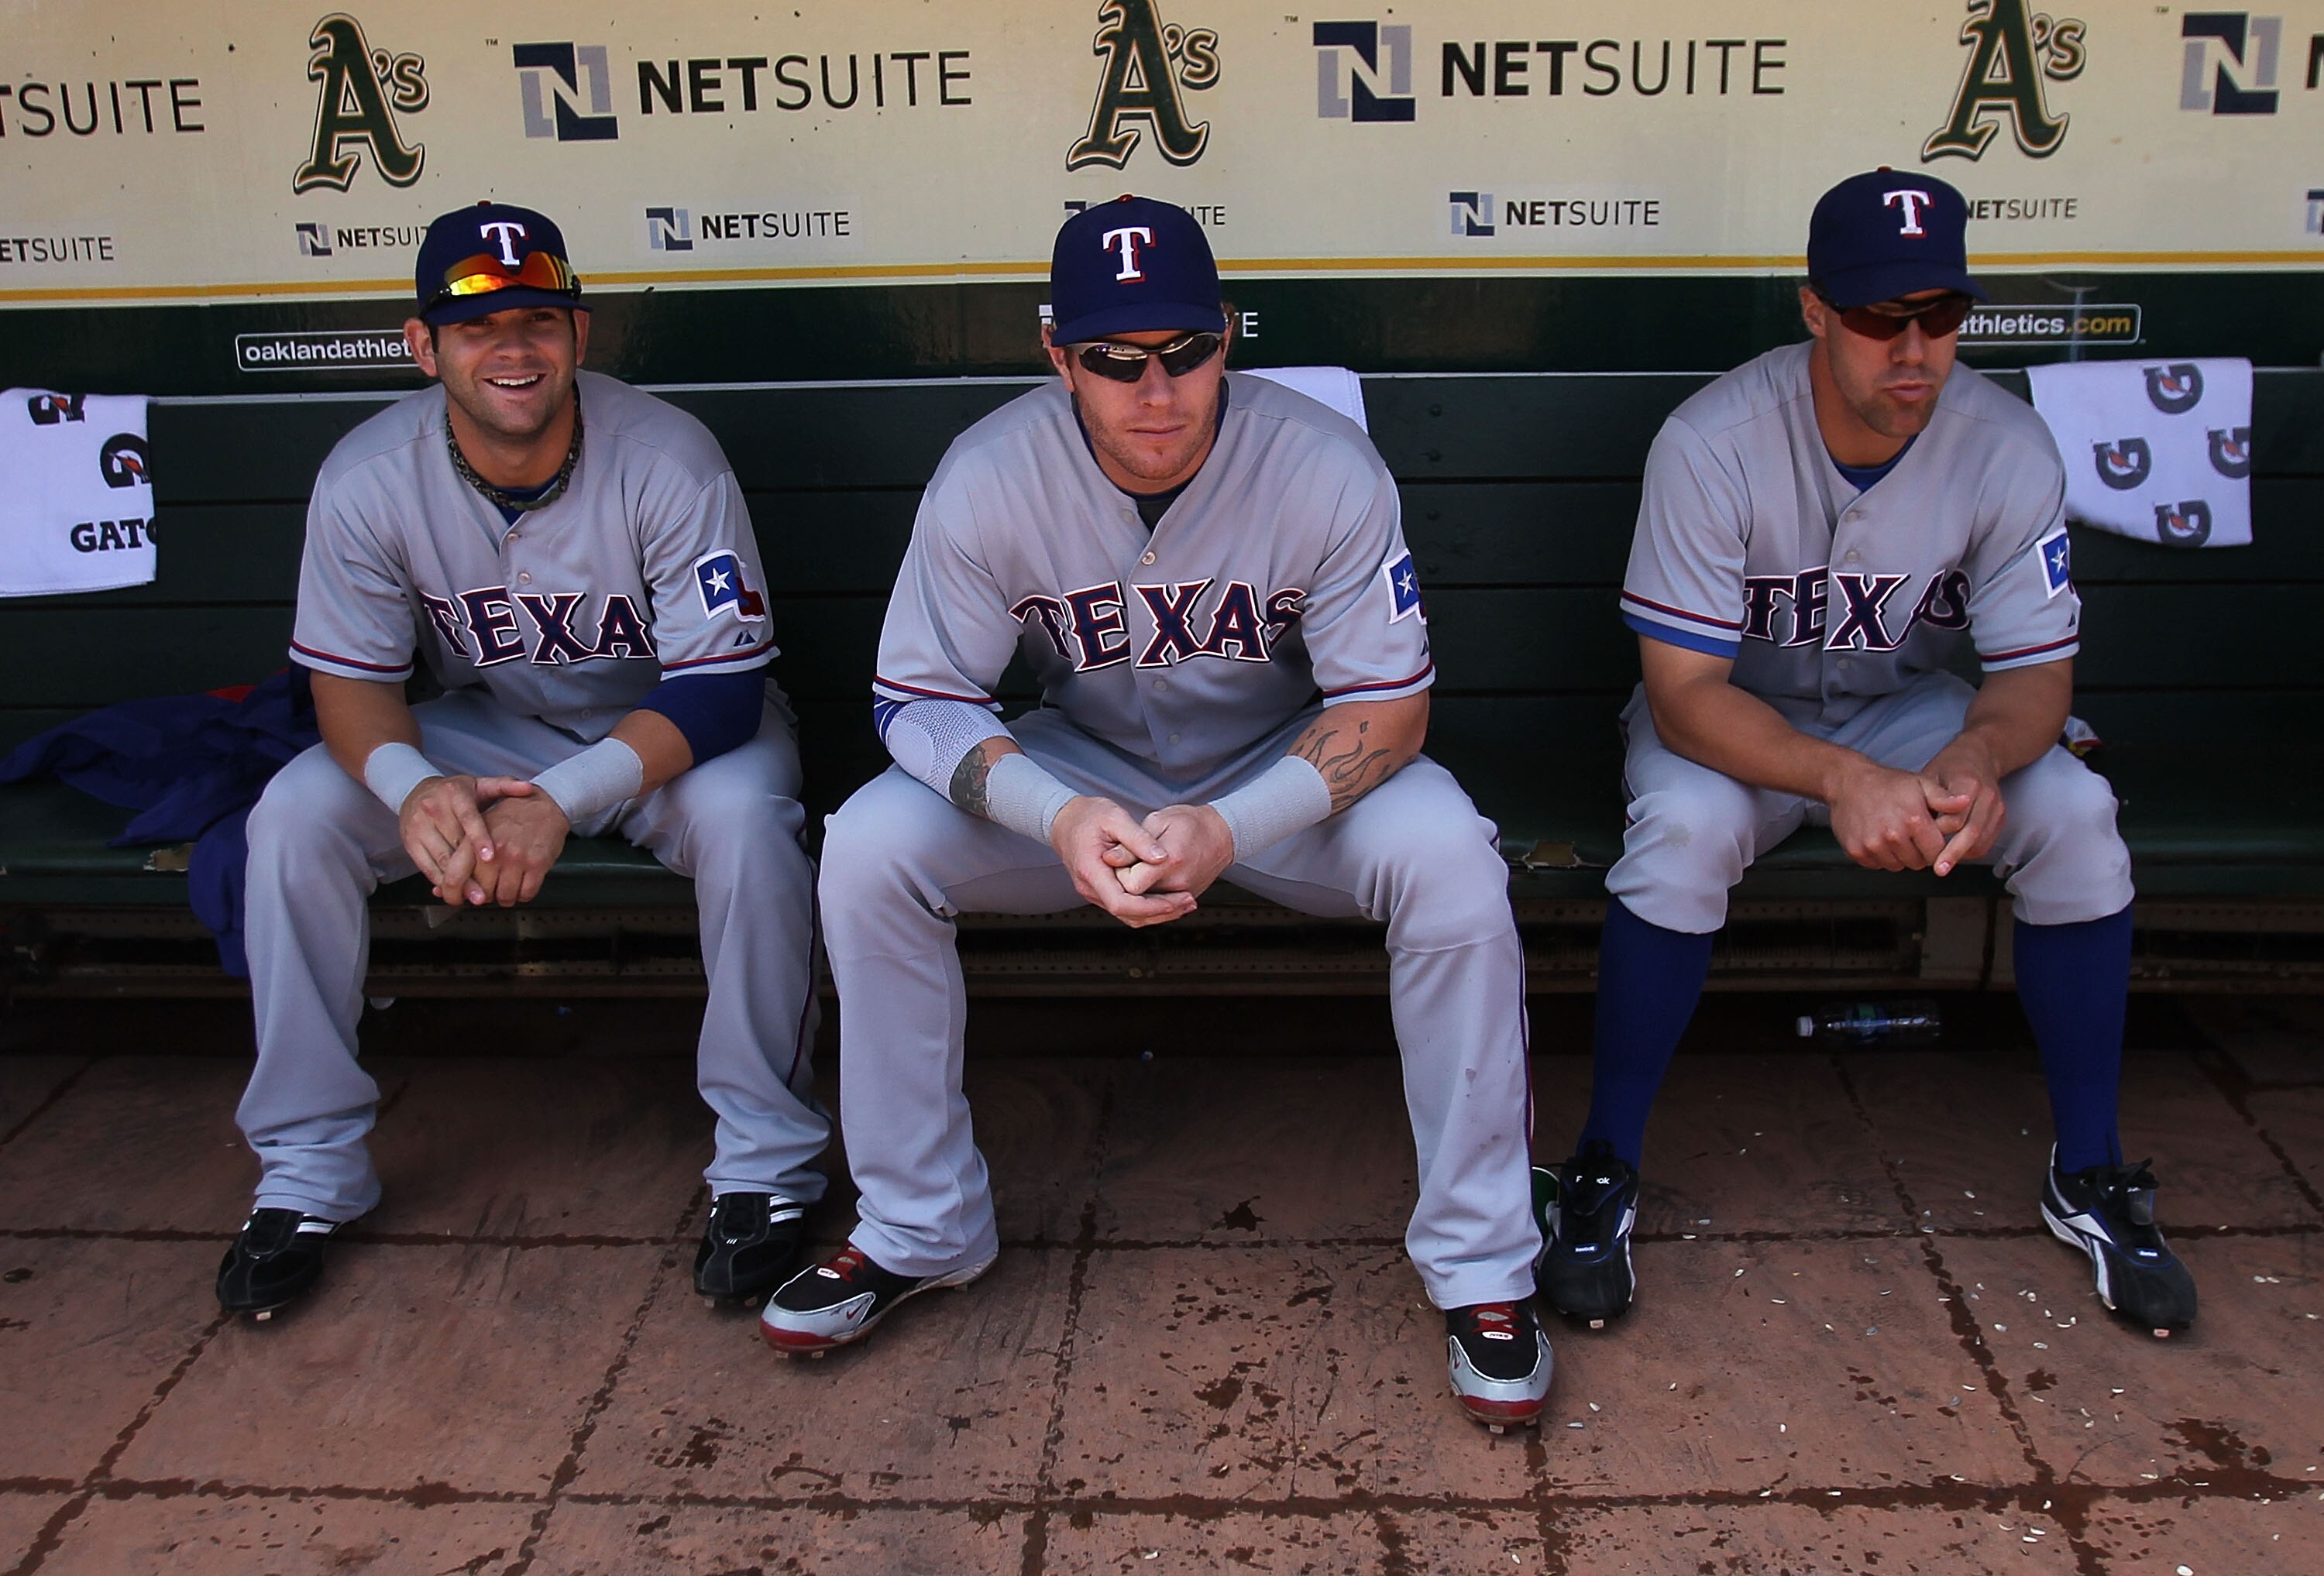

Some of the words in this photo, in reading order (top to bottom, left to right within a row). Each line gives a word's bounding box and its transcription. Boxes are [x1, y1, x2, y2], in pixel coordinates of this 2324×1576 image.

[638, 50, 971, 115] NETSUITE
[1442, 39, 1786, 98] NETSUITE
[293, 12, 430, 194] A's
[701, 211, 850, 240] NETSUITE
[1505, 200, 1660, 226] NETSUITE
[1883, 190, 1934, 239] T
[0, 236, 114, 263] ETSUITE
[480, 221, 531, 267] T
[1102, 227, 1157, 283] T
[1009, 579, 1308, 673] TEXAS
